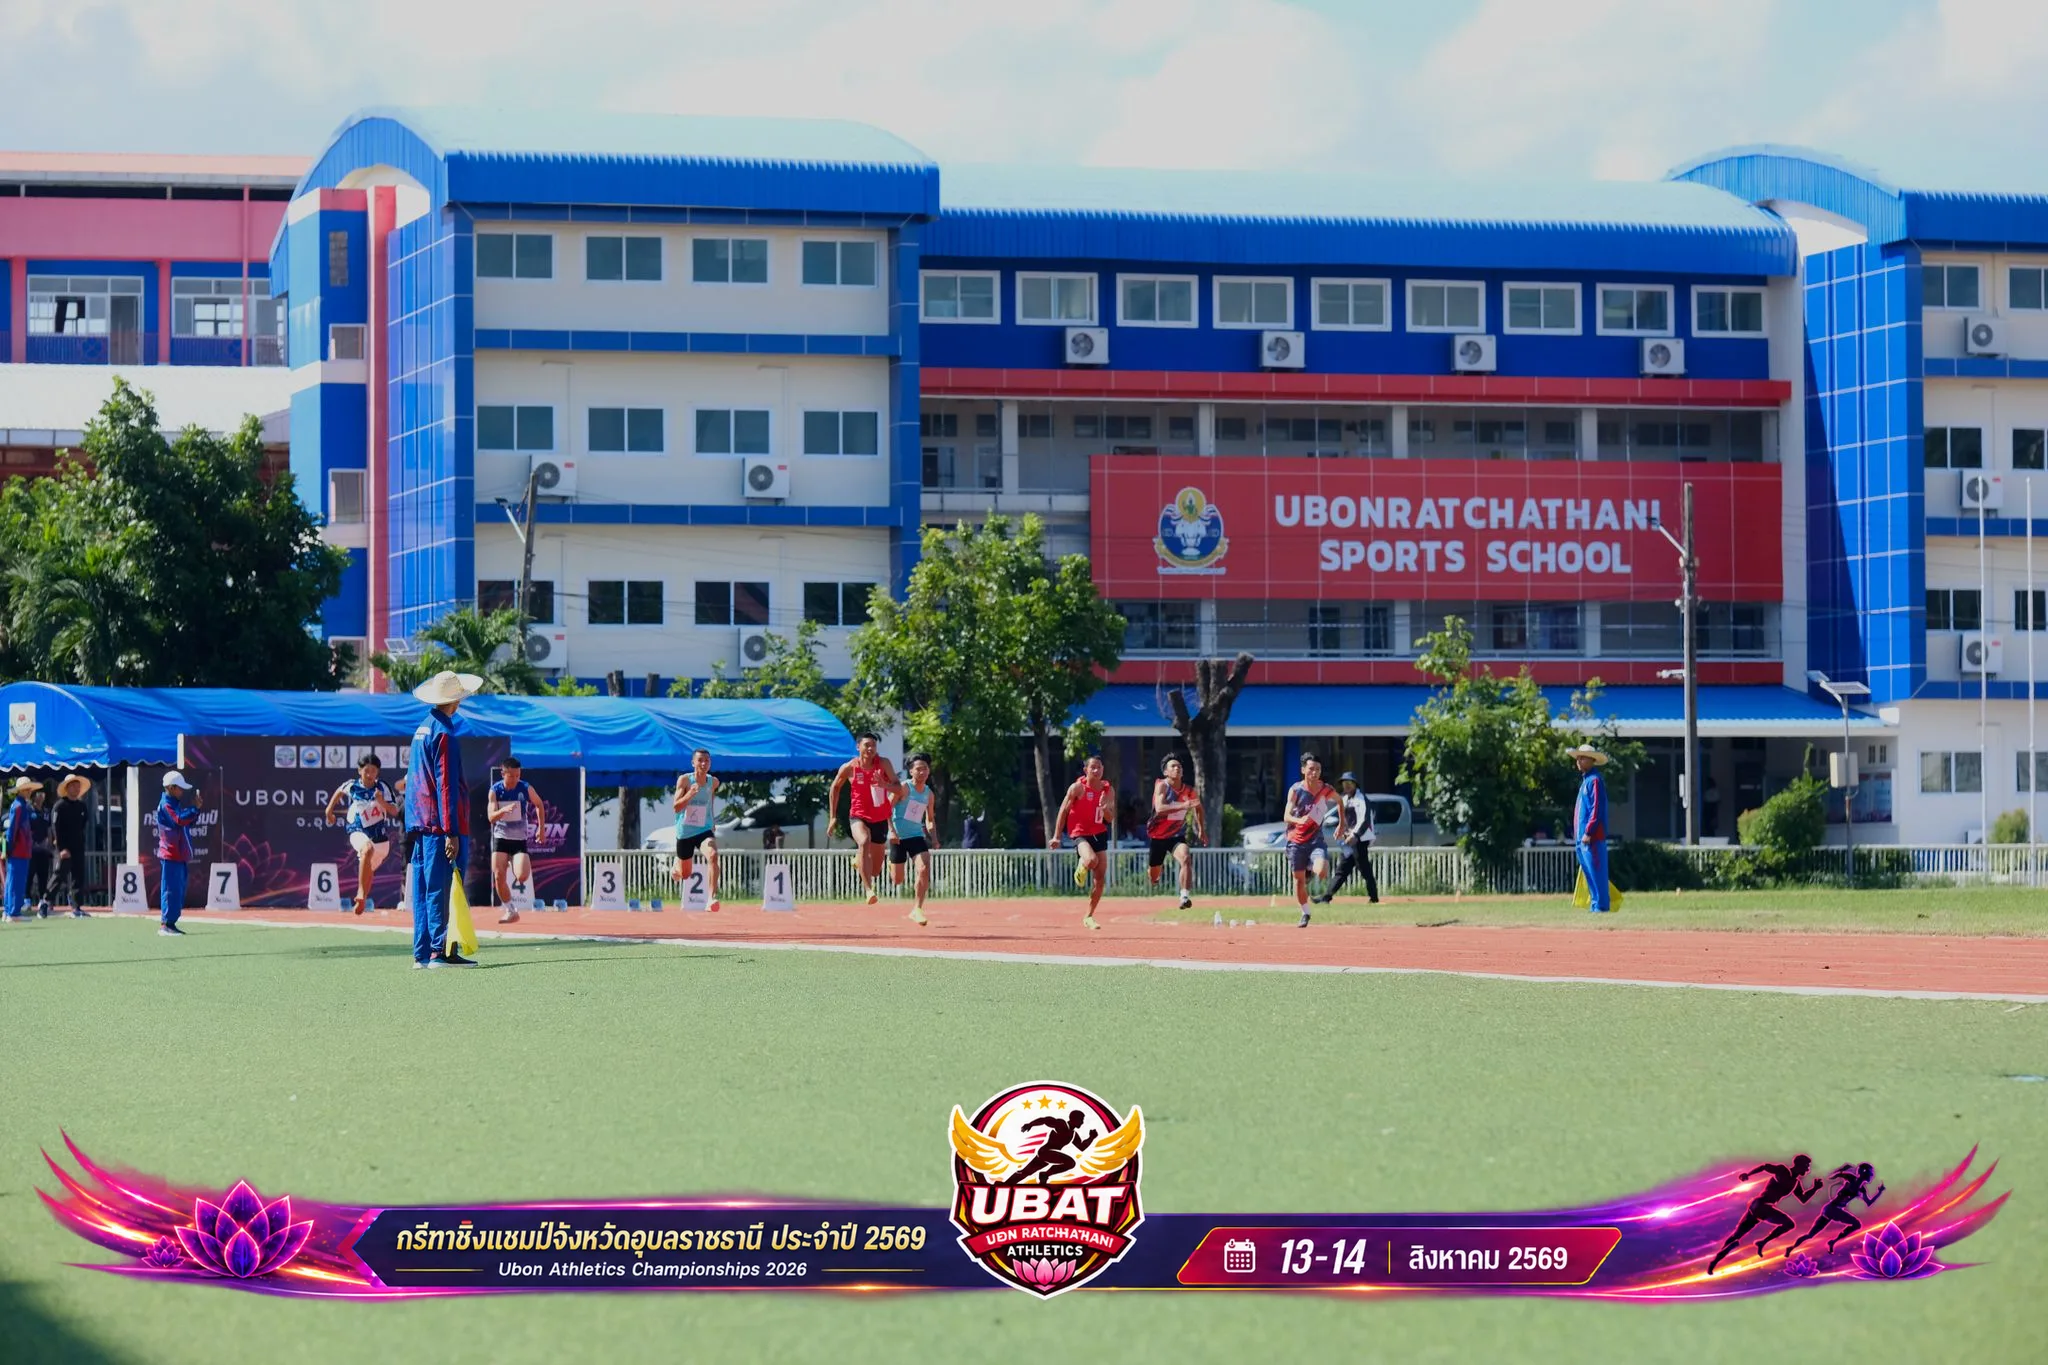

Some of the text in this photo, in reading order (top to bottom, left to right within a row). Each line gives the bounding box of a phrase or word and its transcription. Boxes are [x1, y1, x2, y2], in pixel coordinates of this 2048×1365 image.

[1274, 495, 1660, 531] UBONRATCHATHANI
[1320, 539, 1632, 574] SPORTS SCHOOL
[235, 789, 304, 806] UBON
[123, 871, 138, 895] 8
[216, 871, 232, 895] 7
[317, 870, 332, 893] 6
[602, 870, 616, 894] 3
[690, 871, 704, 894] 2
[773, 871, 784, 895] 1
